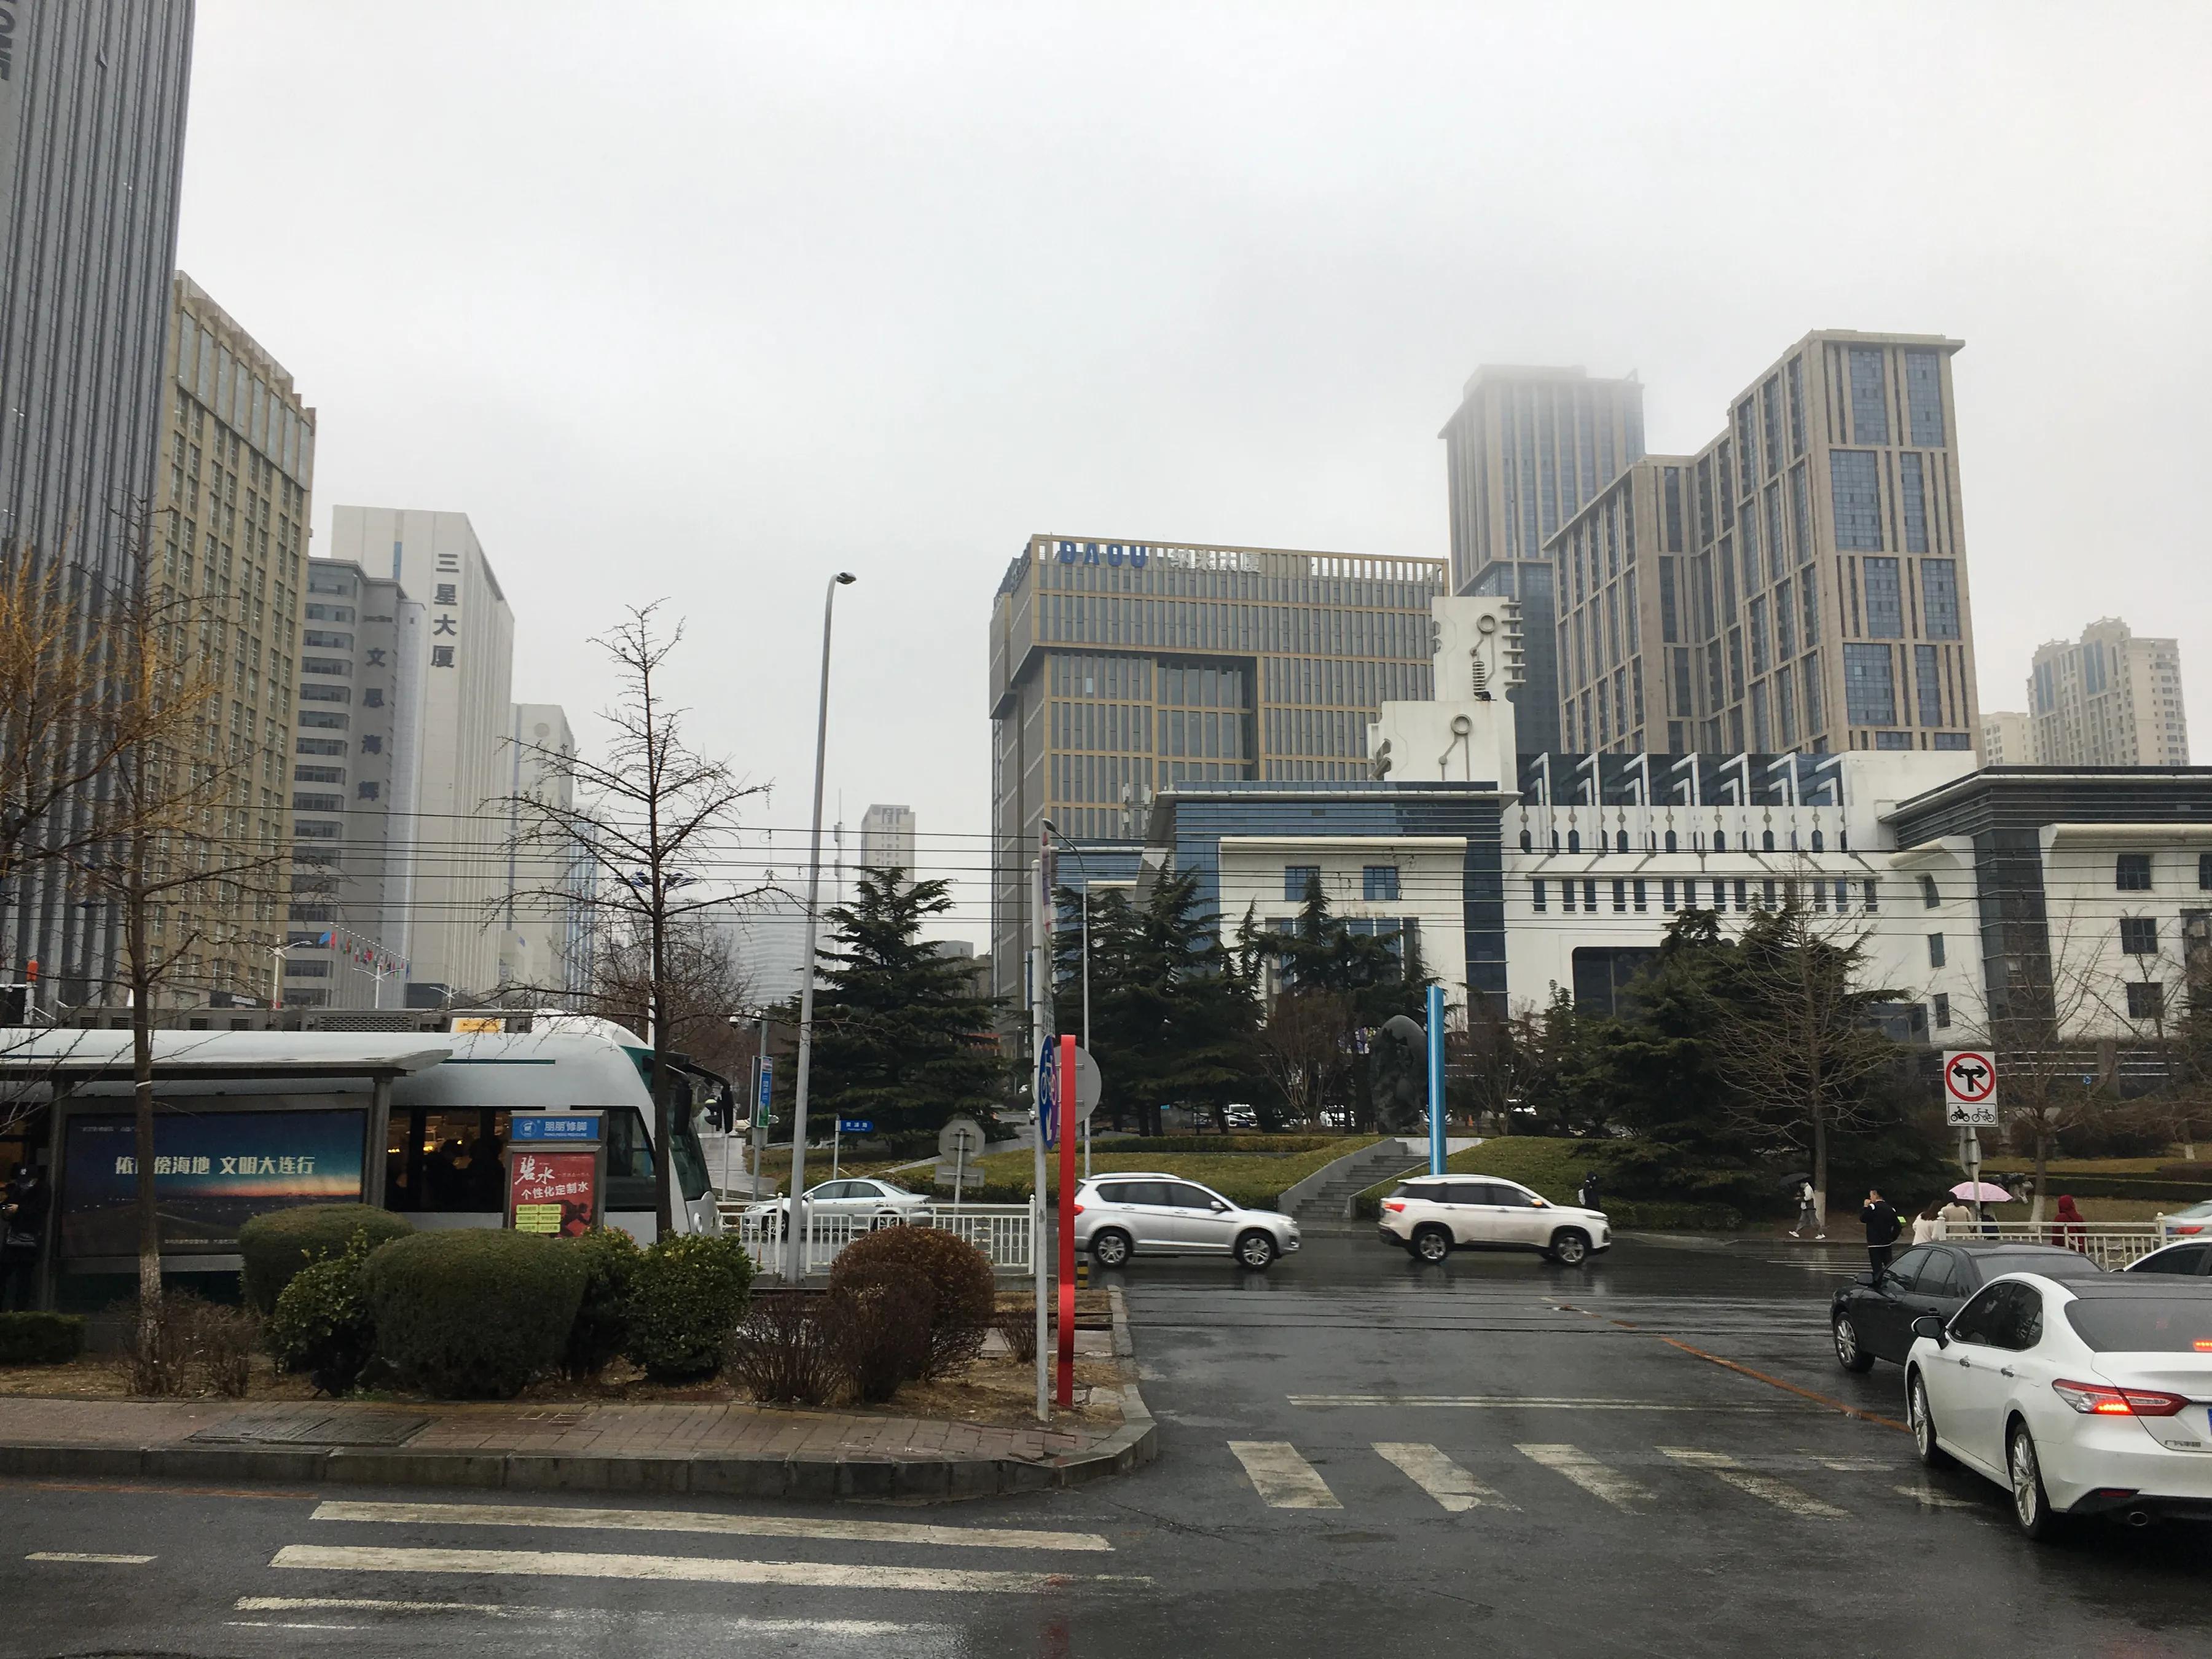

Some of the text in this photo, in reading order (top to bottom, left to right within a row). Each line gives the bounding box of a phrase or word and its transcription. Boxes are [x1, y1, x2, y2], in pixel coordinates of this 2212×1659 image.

[1059, 541, 1146, 568] DAOU
[431, 552, 460, 669] 三星大厦
[115, 1155, 315, 1175] 依傍海地 文明大连行
[514, 1155, 555, 1185] 碧水
[521, 1181, 589, 1201] 个性化定制水
